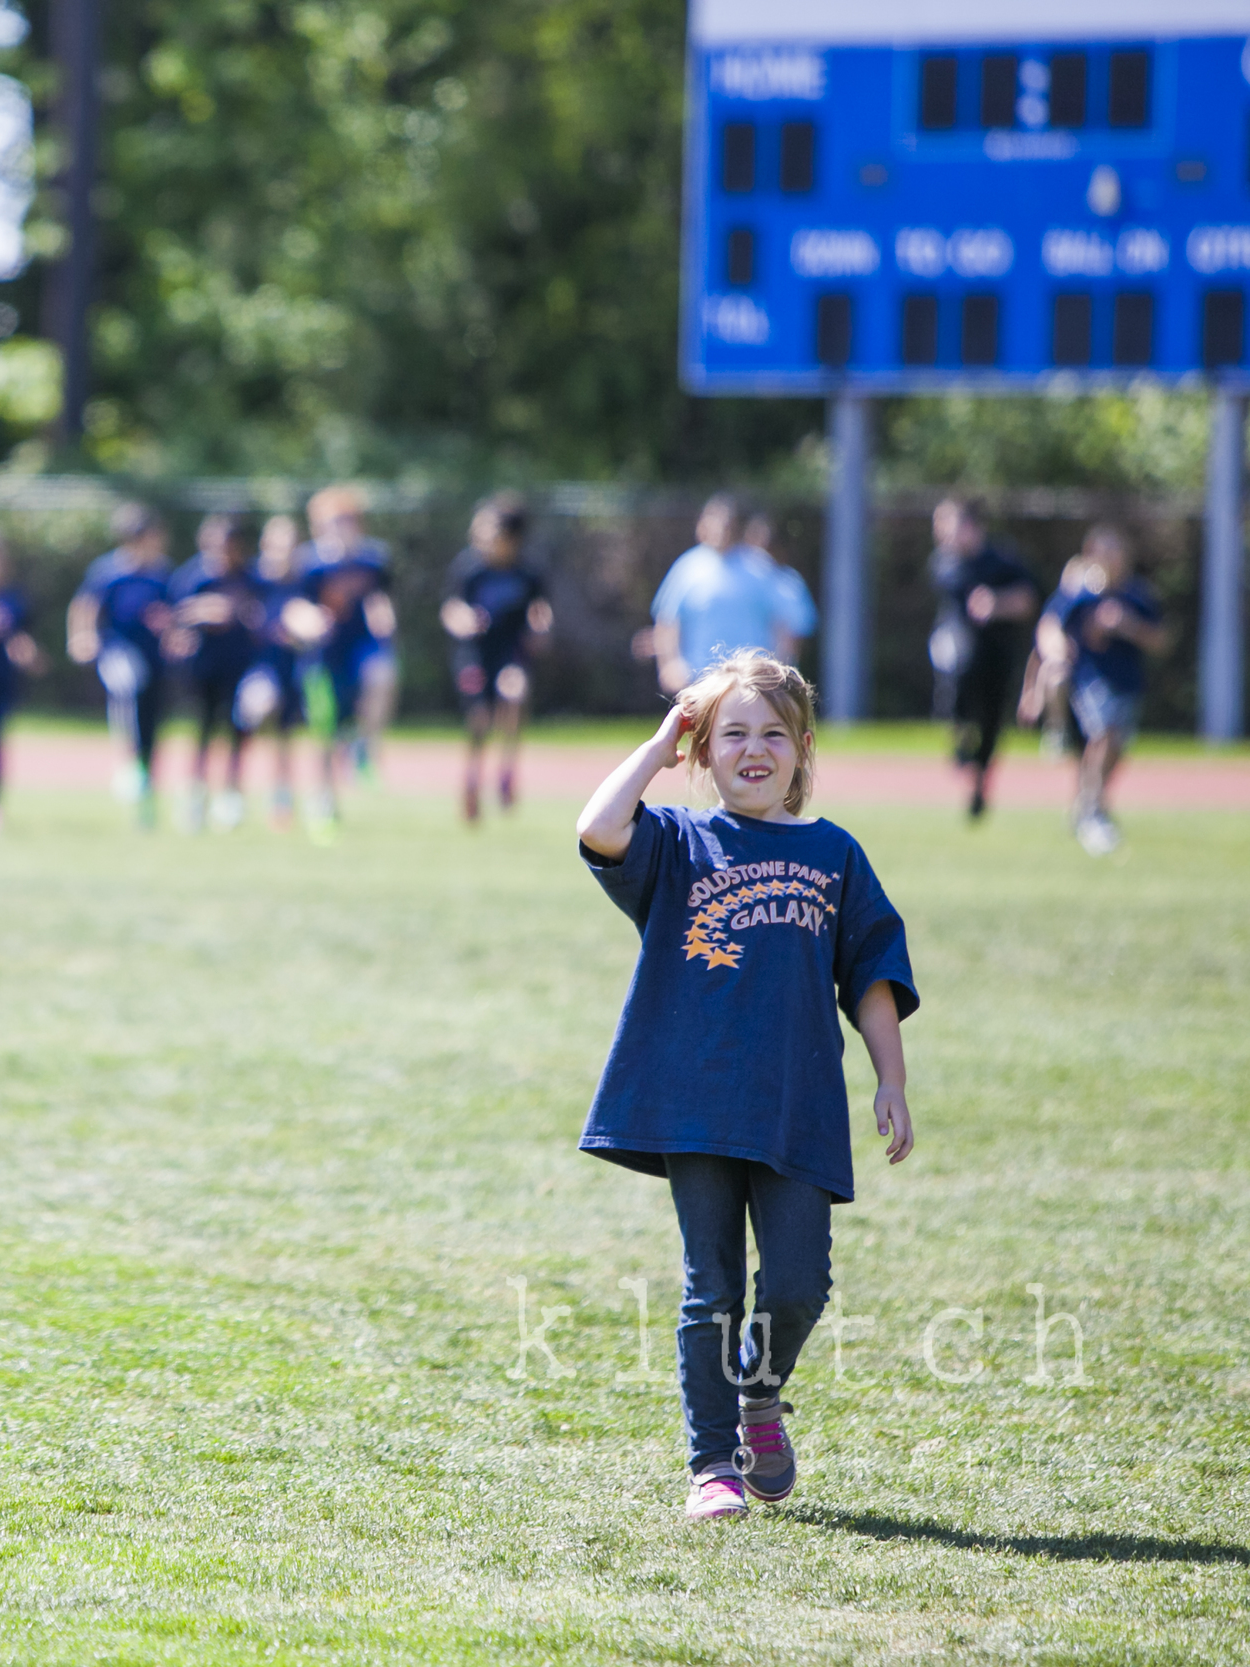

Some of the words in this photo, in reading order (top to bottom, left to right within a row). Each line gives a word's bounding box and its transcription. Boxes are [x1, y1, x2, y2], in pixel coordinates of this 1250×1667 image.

[687, 861, 785, 907] GOLDSTONE
[788, 863, 832, 890] PARK
[730, 900, 824, 937] GALAXY
